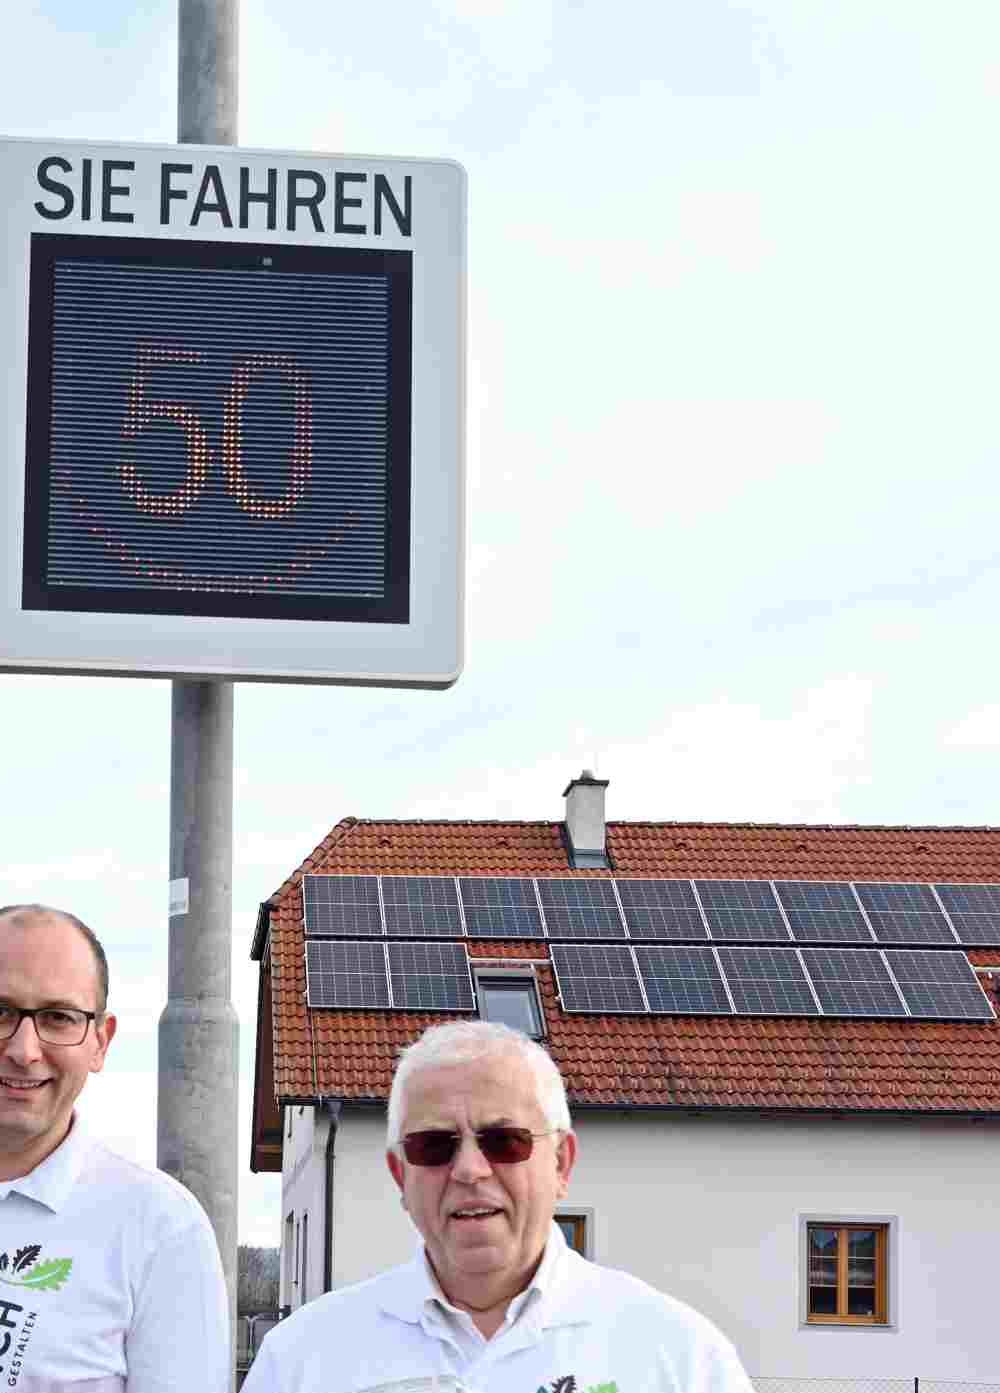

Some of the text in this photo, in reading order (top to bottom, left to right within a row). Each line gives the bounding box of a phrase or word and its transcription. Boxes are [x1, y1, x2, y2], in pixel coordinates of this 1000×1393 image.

[33, 155, 413, 237] SIE FAHREN
[118, 346, 313, 518] 50
[7, 1310, 38, 1387] GESTALTEN
